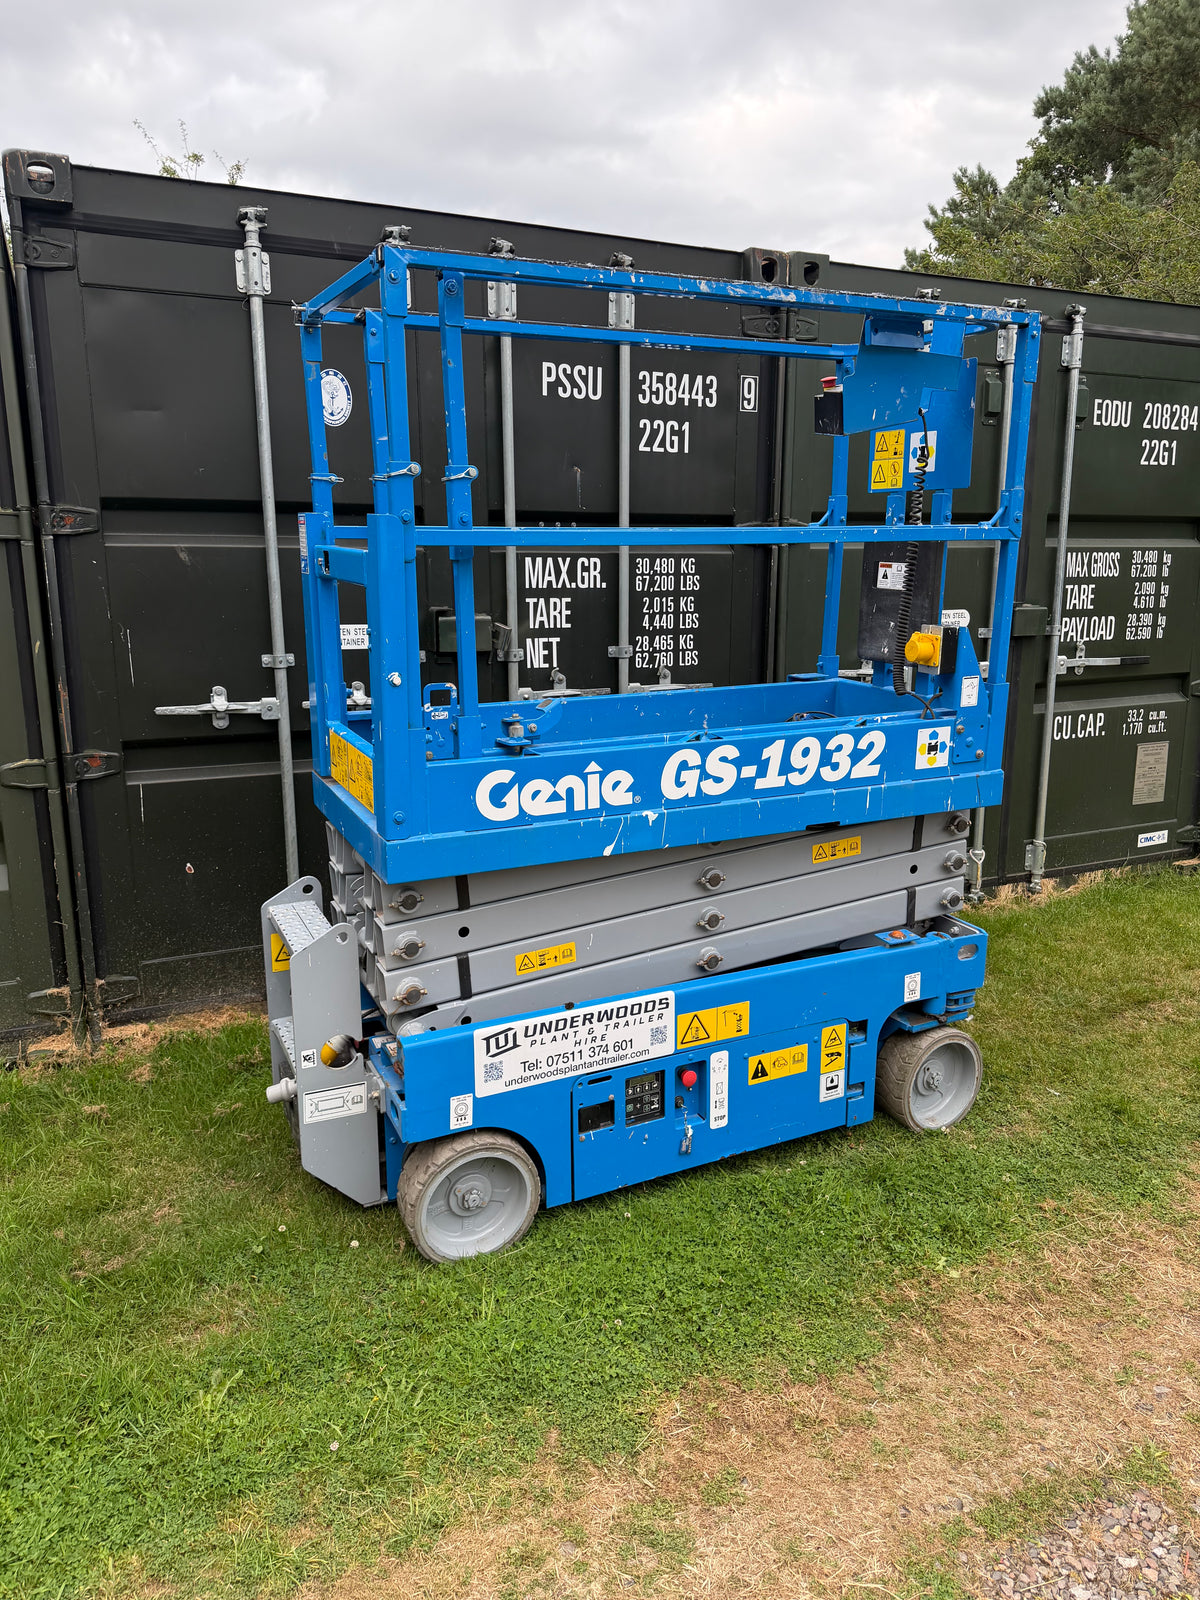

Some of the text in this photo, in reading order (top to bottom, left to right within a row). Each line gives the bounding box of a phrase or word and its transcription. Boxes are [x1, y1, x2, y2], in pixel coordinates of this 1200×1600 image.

[542, 361, 756, 410] PSSU 358443 9
[1093, 398, 1198, 431] EODU 208284
[638, 418, 690, 454] 22G1
[1140, 439, 1177, 466] 22G1
[635, 557, 696, 575] 30,480 KG
[1066, 551, 1120, 578] MAX GROSS
[1163, 550, 1172, 566] kg
[525, 557, 607, 589] MAX.GR.
[1162, 564, 1169, 577] lb
[635, 575, 700, 593] 67,200 LBS
[1160, 581, 1170, 597] kg
[642, 596, 694, 614] 2,015 KG
[1065, 584, 1096, 610] TARE
[1159, 595, 1167, 608] lb
[525, 597, 571, 629] TARE
[642, 613, 699, 632] 4,440 LBS
[1157, 613, 1167, 628] kg
[353, 627, 367, 636] STE
[1060, 616, 1116, 643] PAYLOAD
[525, 637, 560, 669] NET
[635, 634, 694, 652] 28,465 KG
[635, 651, 699, 669] 62,760 LBS
[1053, 712, 1106, 741] CU.CAP.
[1127, 708, 1145, 723] 33.2
[660, 730, 887, 801] GS-1932
[1139, 835, 1156, 844] CIMC
[523, 997, 670, 1038] UNDERWOODS
[530, 1012, 664, 1048] PLANT & TRAILER
[574, 1033, 608, 1048] HIRE
[520, 1037, 634, 1073] Tel: 07511 374 601
[504, 1047, 650, 1088] underwoodsplantandtrailer.com
[713, 1114, 727, 1122] STOP
